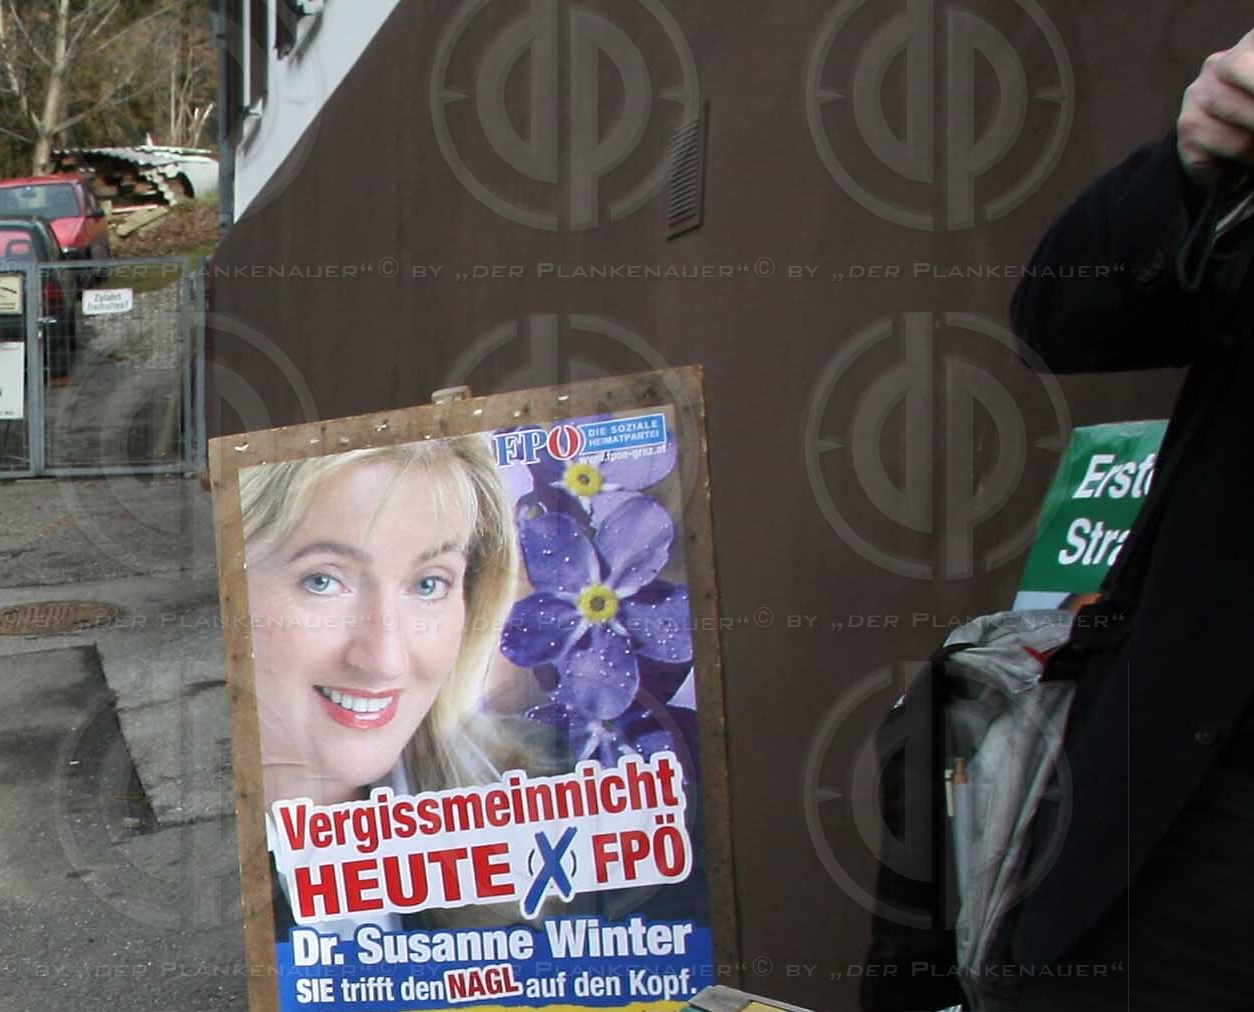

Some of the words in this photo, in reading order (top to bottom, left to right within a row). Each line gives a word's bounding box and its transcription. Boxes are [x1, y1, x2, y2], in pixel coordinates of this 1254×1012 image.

[587, 427, 607, 438] DIE
[610, 419, 659, 434] SOZIALE
[588, 430, 660, 447] HEIMATPARTEI
[278, 756, 682, 854] Vergissmeinnicht
[294, 842, 516, 919] HEUTE
[591, 814, 687, 885] FPÖ
[292, 928, 344, 967] Dr.
[357, 926, 535, 966] Susanne
[545, 917, 693, 962] Winter
[295, 977, 335, 1003] SIE
[340, 974, 394, 1002] trifft
[402, 975, 445, 1001] den
[447, 969, 521, 1001] NAGL
[526, 973, 566, 998] auf
[576, 971, 625, 998] den
[629, 971, 698, 1003] Kopf.
